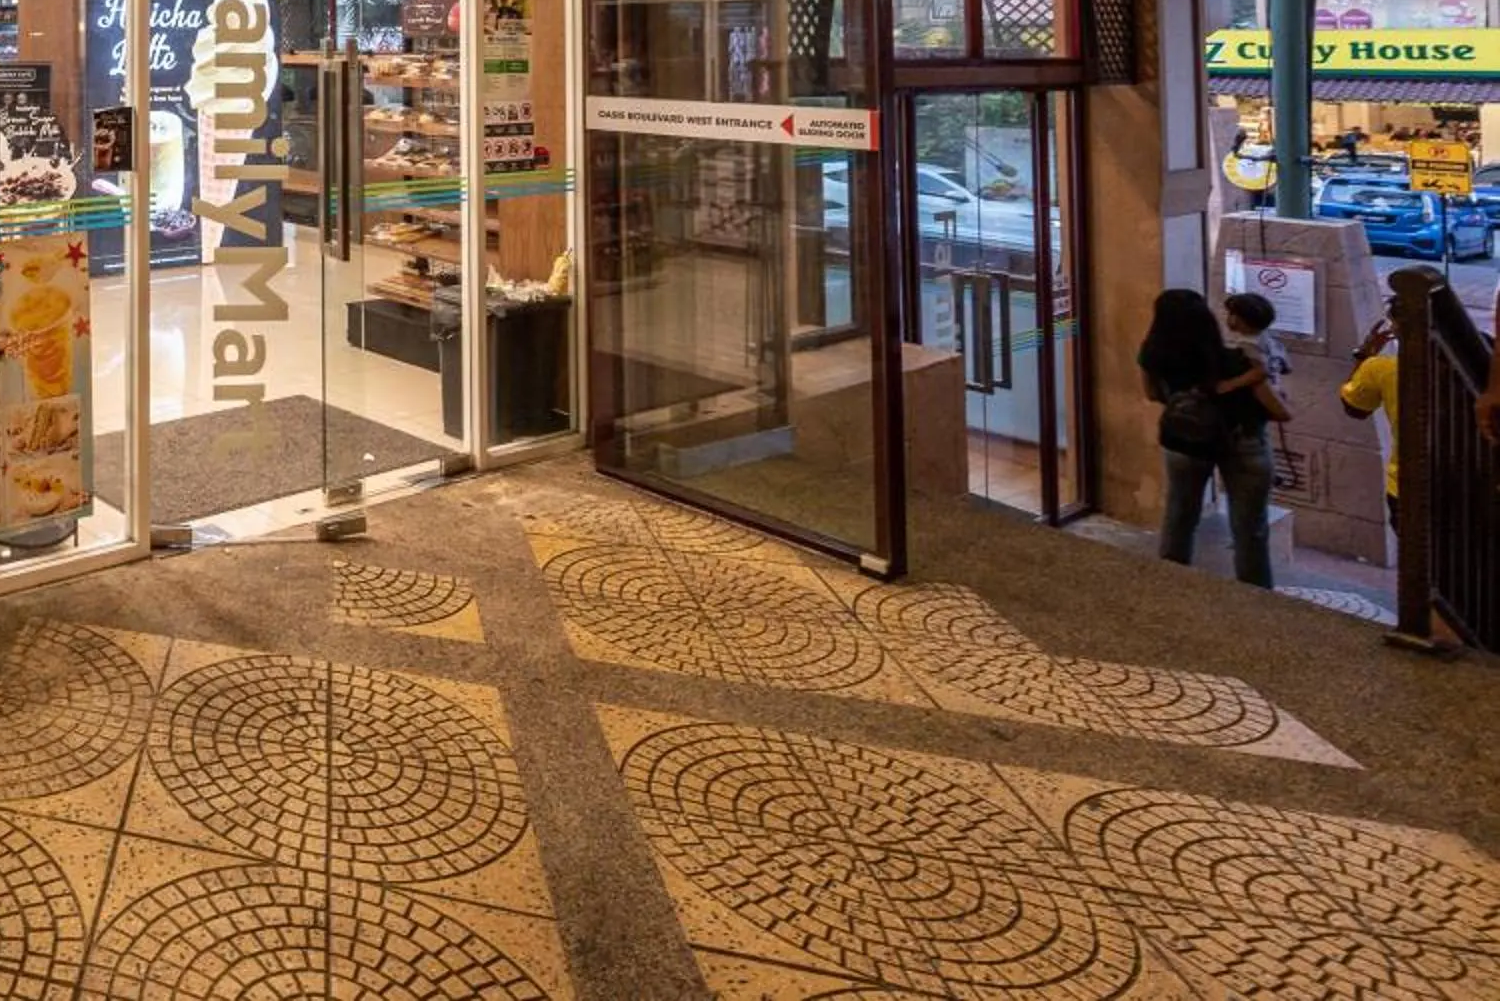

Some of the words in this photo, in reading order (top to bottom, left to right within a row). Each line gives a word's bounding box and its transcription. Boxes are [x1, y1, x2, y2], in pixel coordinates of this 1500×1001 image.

[1237, 42, 1337, 63] Cuy
[1348, 41, 1477, 60] House
[598, 110, 625, 120] OASIS
[627, 112, 684, 124] BOULEVARD
[686, 116, 712, 126] WEST
[715, 117, 773, 130] ENTRANCE
